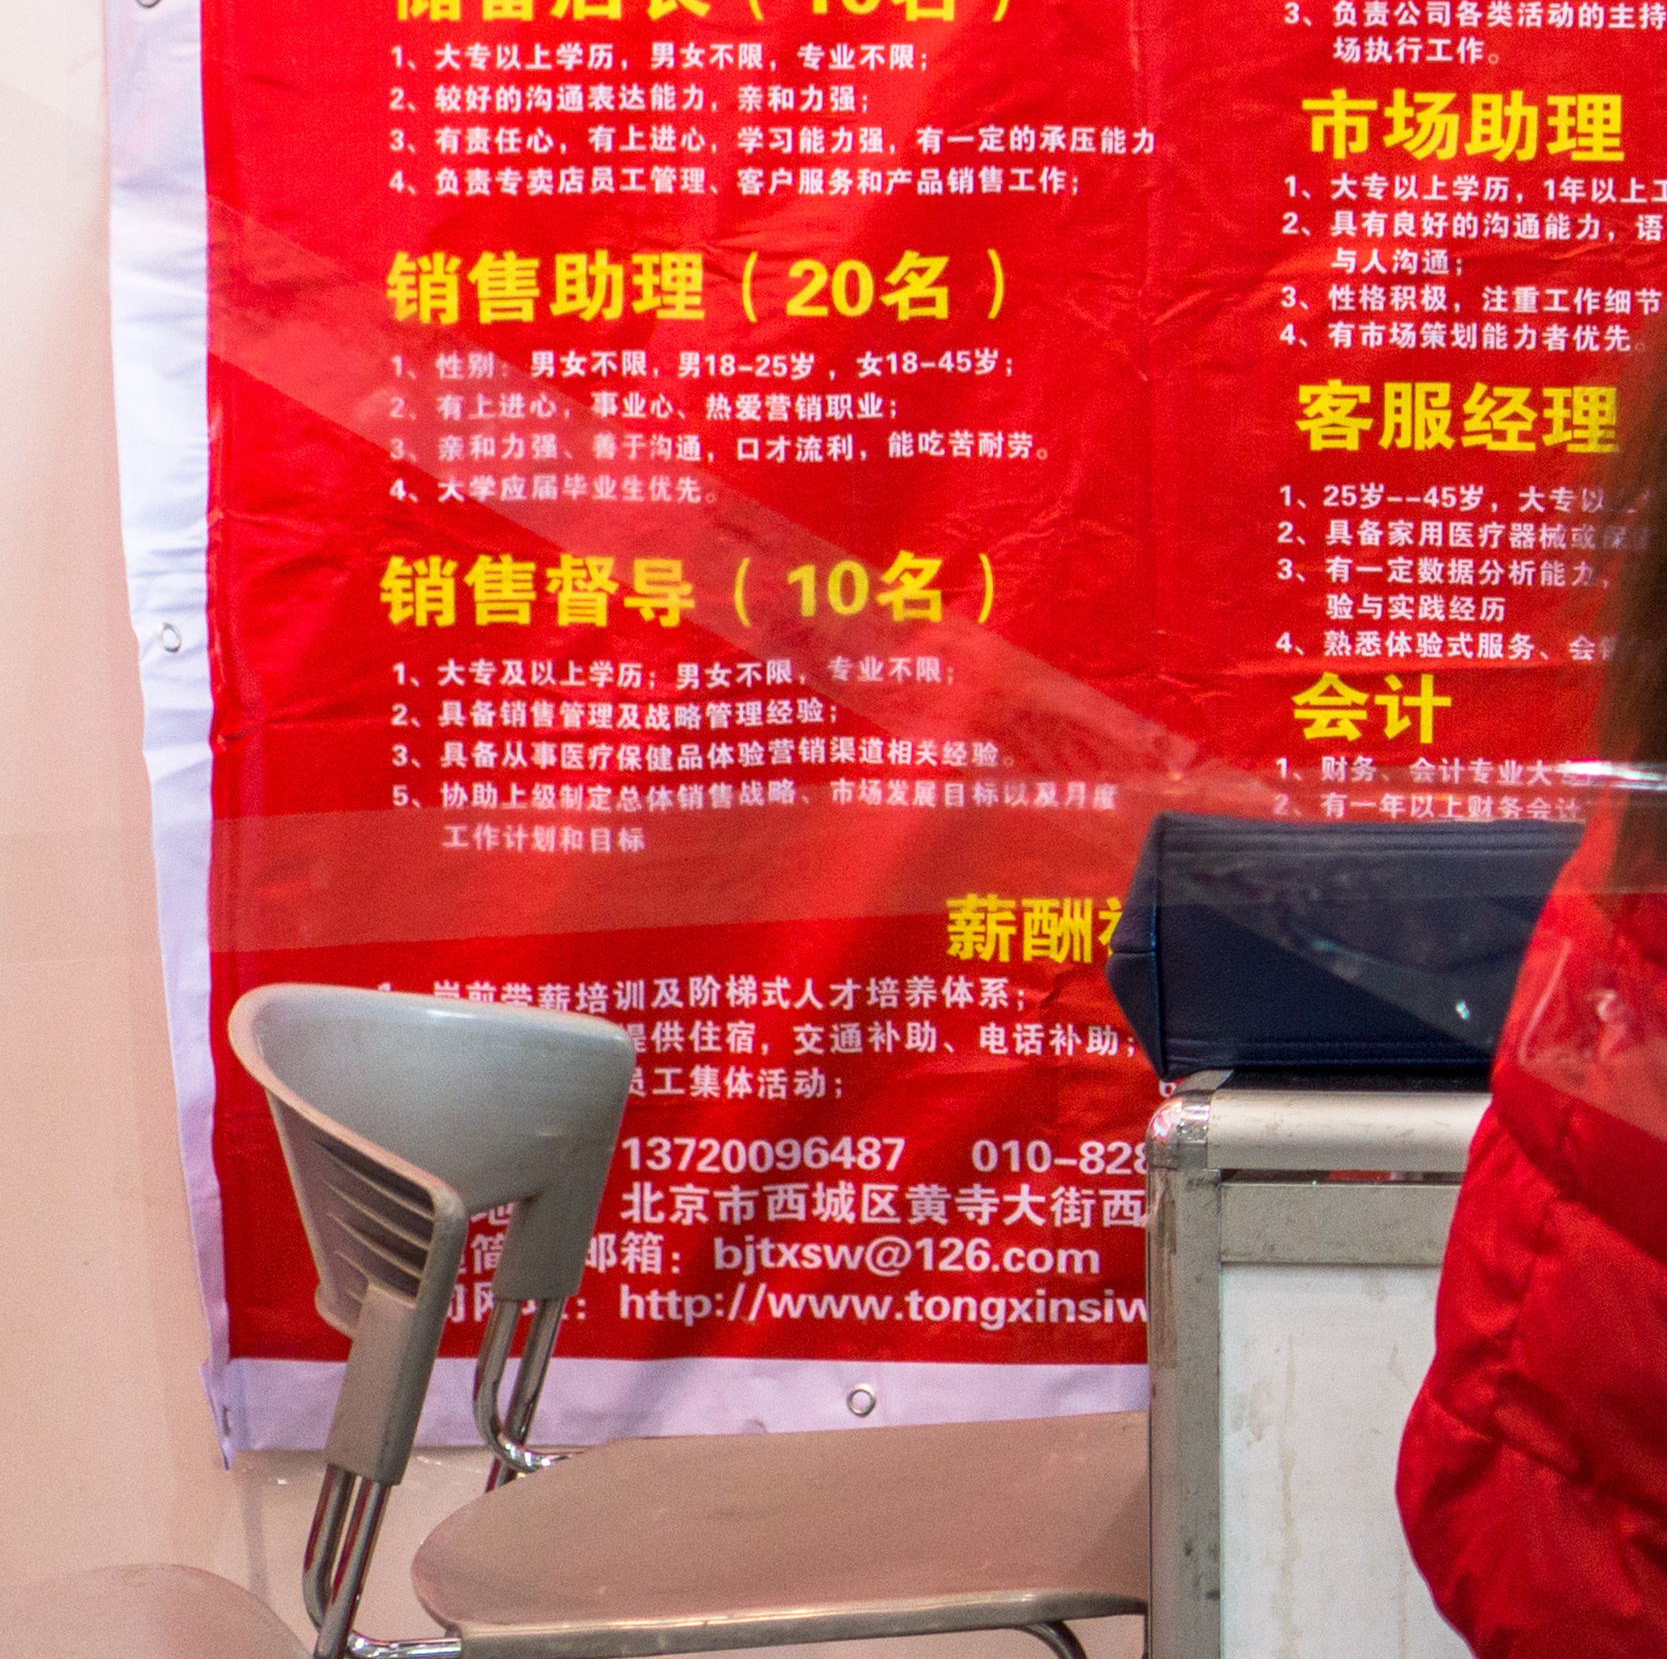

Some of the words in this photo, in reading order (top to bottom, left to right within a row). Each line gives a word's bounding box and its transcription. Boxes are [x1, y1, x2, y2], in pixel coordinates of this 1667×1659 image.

[392, 41, 927, 71] 1、大专以上学历，男女不限，专业不限；
[1333, 37, 1500, 64] 场执行工作。
[390, 83, 868, 113] 2、较好的沟通表达能力，亲和力强；
[390, 124, 1155, 155] 3、有责任心，有上进心，学习能力强，有一定的承压能力
[1301, 88, 1625, 162] 市场助理
[389, 165, 1078, 196] 4、负责专卖店员工管理、客户服务和产品销售工作；
[1331, 247, 1462, 275] 与人沟通；
[386, 249, 1005, 325] 销售助理（20名）
[1295, 378, 1618, 454] 客服经理
[1280, 482, 1648, 514] 1、25岁--45岁，大专以
[380, 550, 994, 628] 销售督导（10名）
[1327, 593, 1505, 621] 验与实践经历
[391, 697, 836, 731] 2、具备销售管理及战略管理经验；
[1292, 671, 1452, 744] 会计
[442, 825, 643, 852] 工作计划和目标
[945, 893, 1123, 964] 薪酬
[378, 974, 1028, 1014] 岗前带薪培训及阶梯式人才培养体系；
[624, 1137, 905, 1173] 13720096487
[714, 1235, 1100, 1277] bjtxsw@126.com
